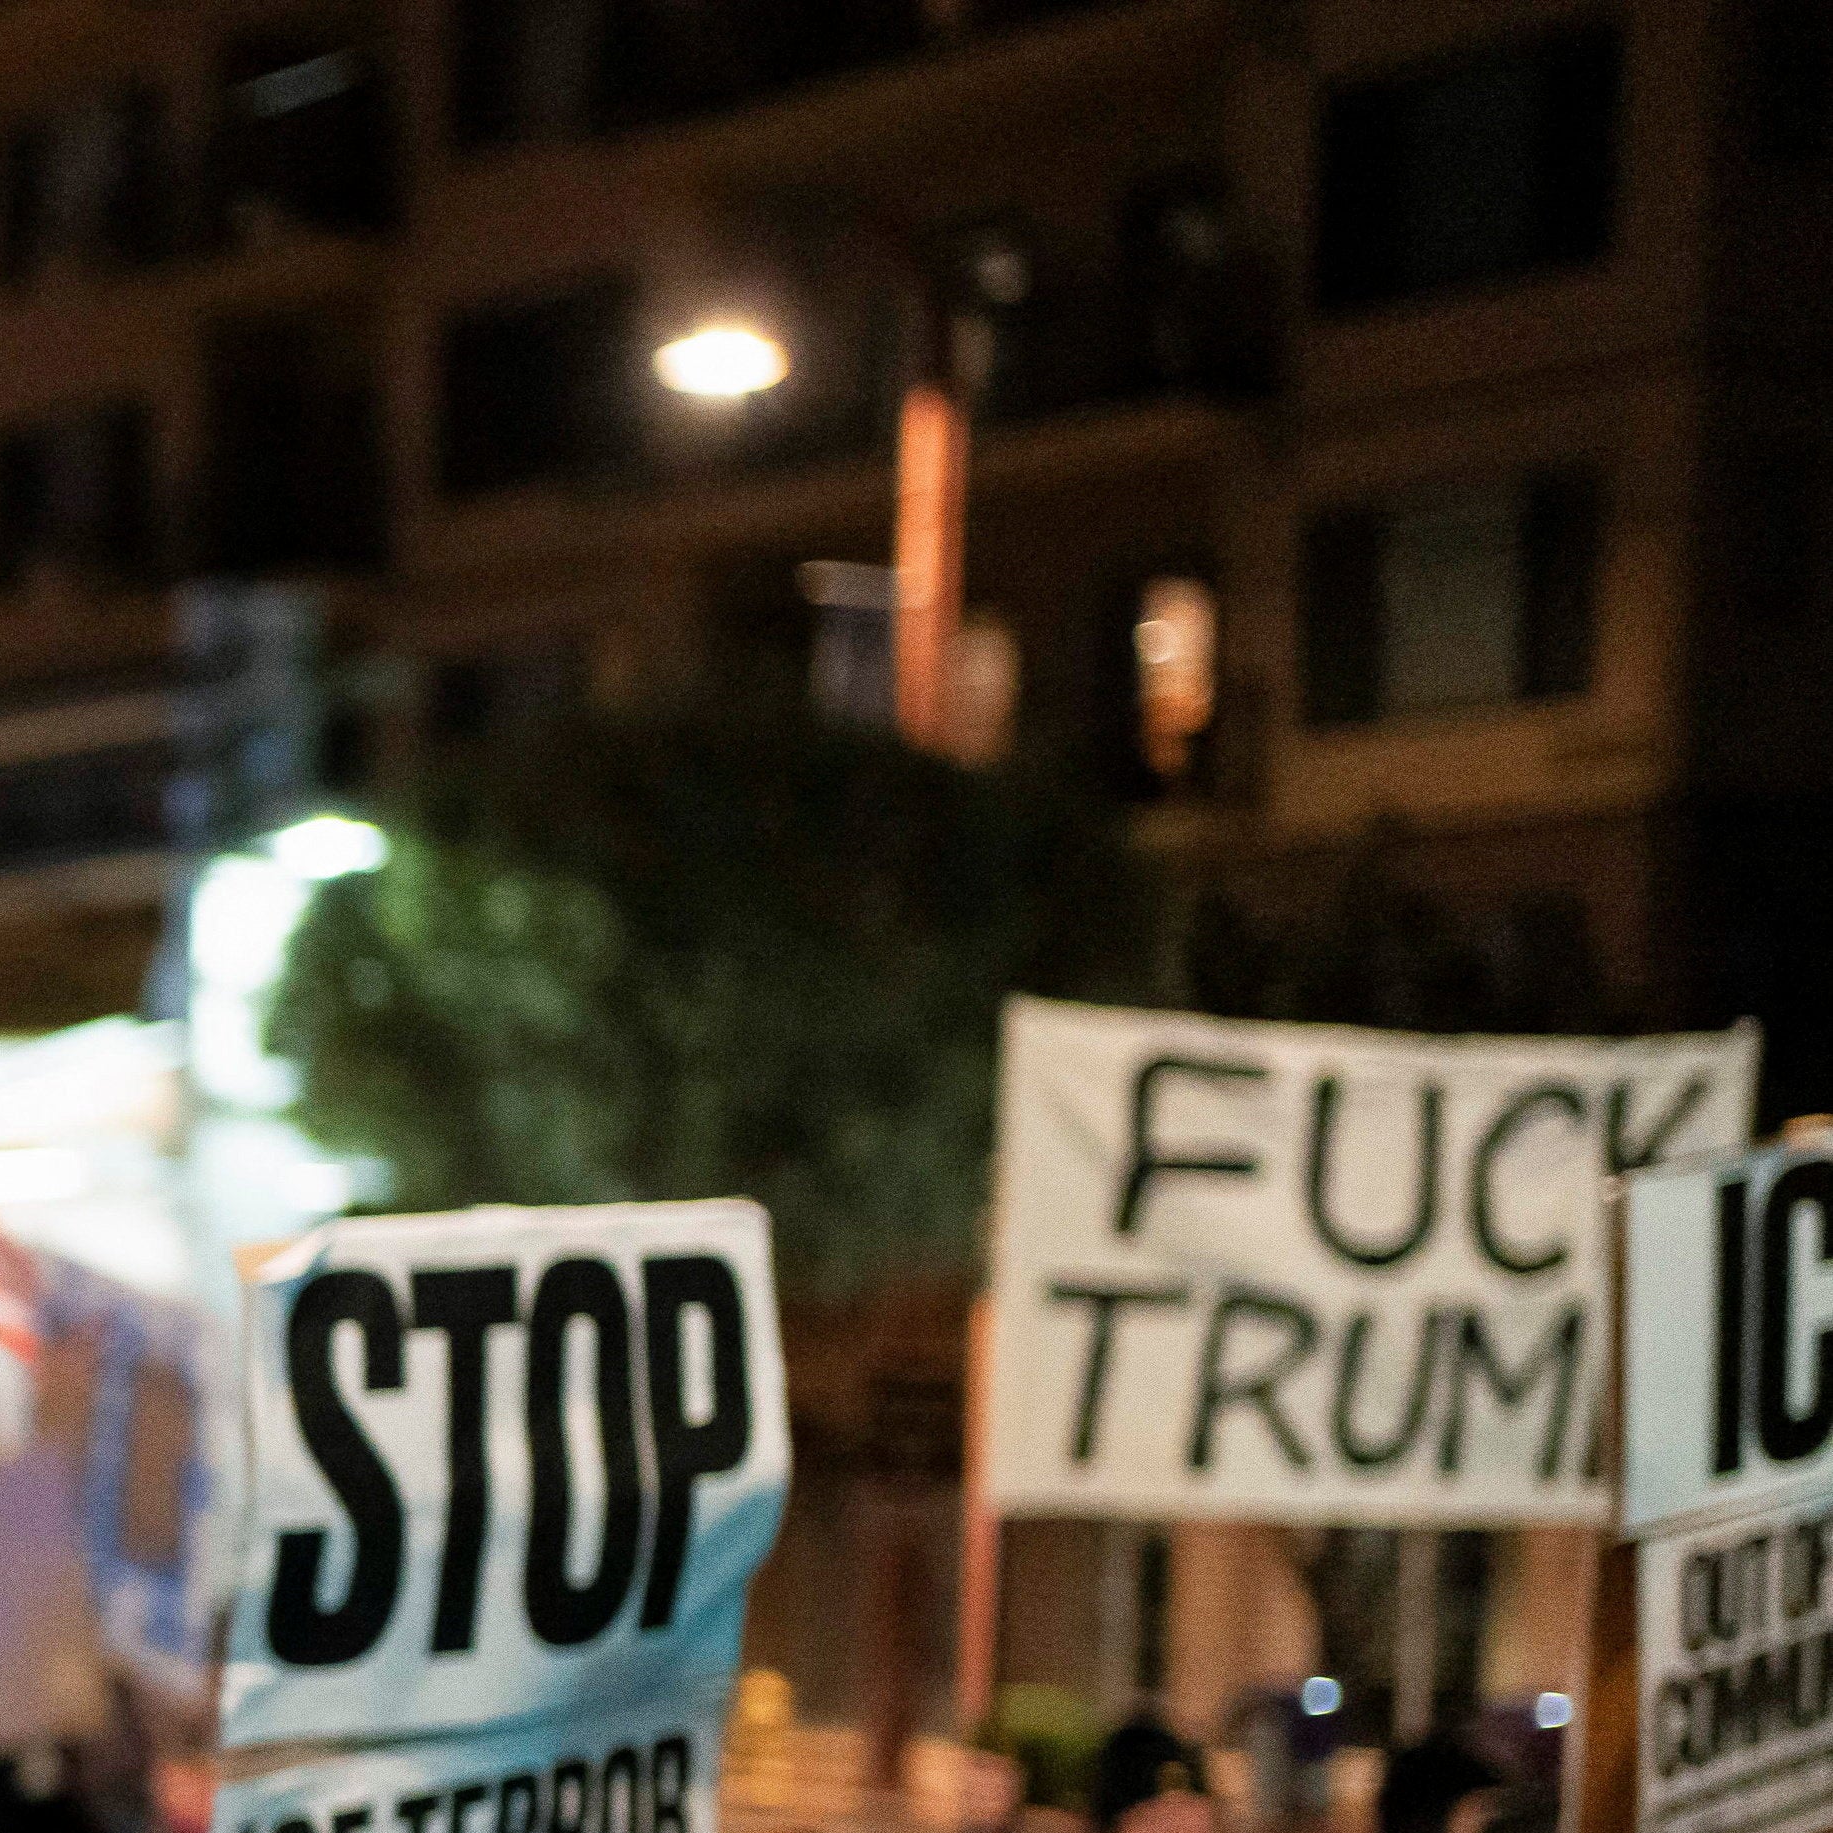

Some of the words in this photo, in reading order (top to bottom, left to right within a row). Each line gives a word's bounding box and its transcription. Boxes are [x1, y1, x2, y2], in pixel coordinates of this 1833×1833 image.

[264, 1254, 753, 1669] STOP
[1043, 1278, 1605, 1484] TRUM
[1711, 1160, 1833, 1475] IC
